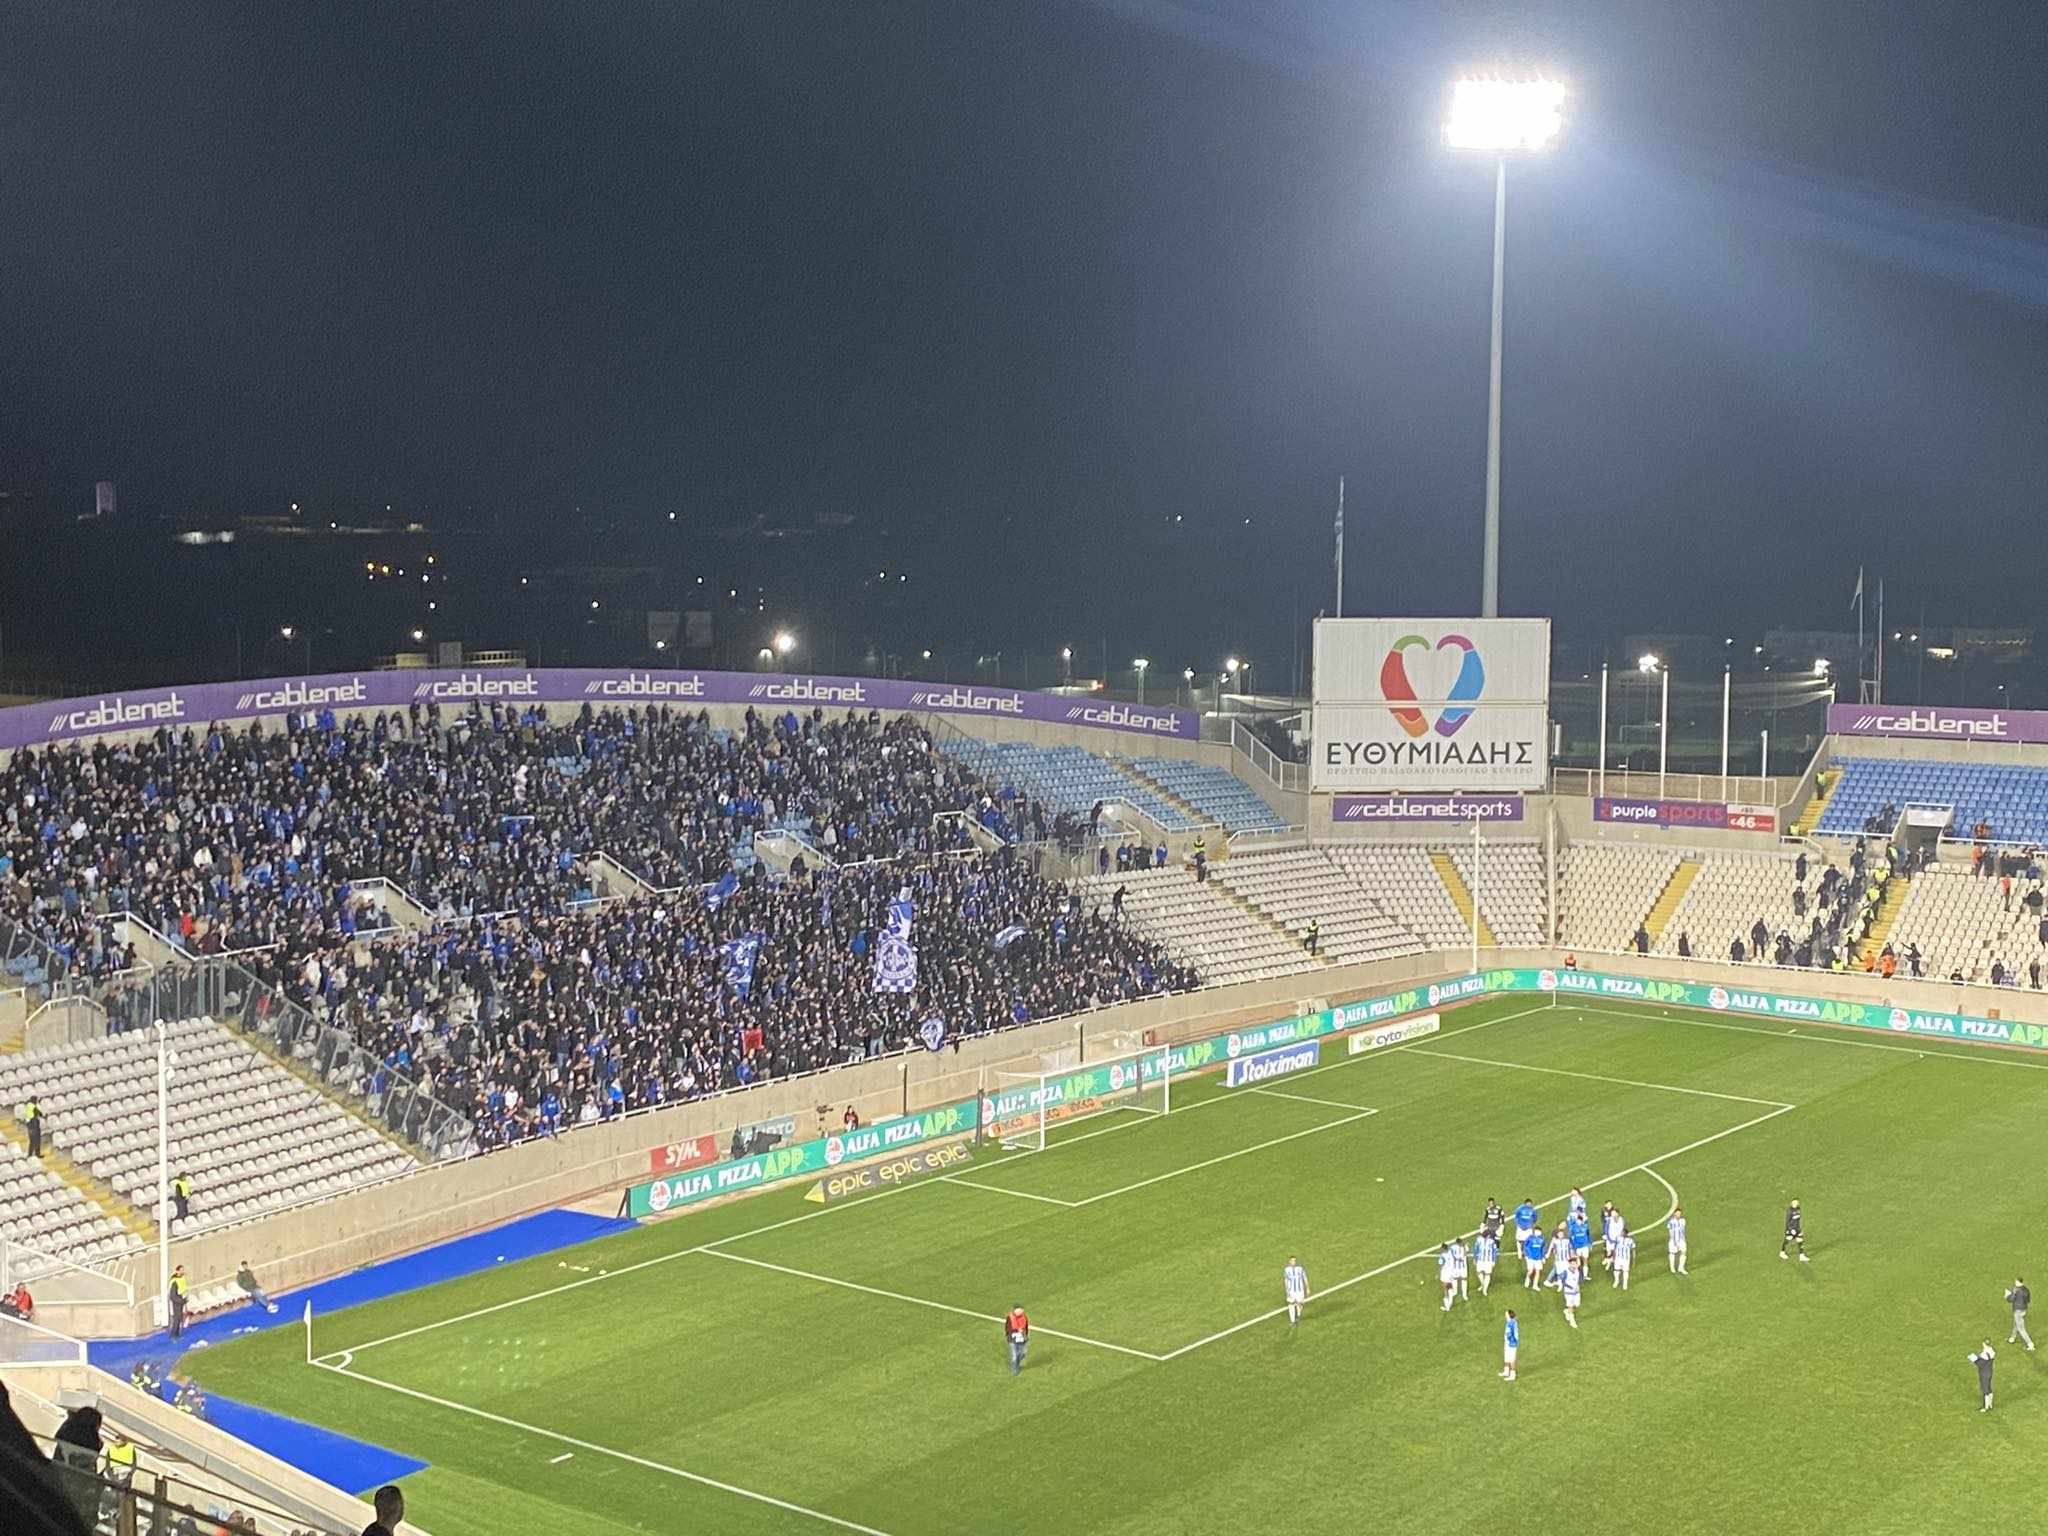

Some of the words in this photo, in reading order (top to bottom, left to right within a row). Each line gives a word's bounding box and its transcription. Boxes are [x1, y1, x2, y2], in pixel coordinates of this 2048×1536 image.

[255, 678, 366, 709] cablenet
[433, 673, 537, 697] cablenet
[603, 674, 704, 696] cablenet
[766, 678, 866, 702] cablenet
[69, 692, 185, 729] cablenet
[927, 688, 1024, 713] cablenet
[1083, 705, 1181, 733] cablenet
[1876, 710, 2008, 736] cablenet
[1327, 742, 1533, 765] ΕΥΘΥΜΙΑΔΗΣ
[1484, 970, 1514, 992] APP
[1561, 974, 1597, 990] ALFA
[1602, 979, 1643, 994] PIZZA
[1644, 981, 1685, 1001] APP
[1393, 991, 1416, 1014] APP
[1731, 994, 1769, 1010] ALFA
[1775, 999, 1820, 1015] PIZZA
[1821, 1001, 1865, 1022] APP
[1295, 1016, 1320, 1037] APP
[1913, 1016, 1955, 1032] ALFA
[1961, 1021, 2009, 1038] PIZZA
[1185, 1042, 1212, 1068] APP
[1239, 1051, 1314, 1085] Stoiximan
[1063, 1074, 1093, 1100] APP
[846, 1131, 880, 1154] ALFA
[885, 1121, 922, 1143] PIZZA
[922, 1108, 958, 1137] APP
[666, 1140, 700, 1167] SYM
[673, 1174, 712, 1199] ALFA
[718, 1161, 762, 1187] PIZZA
[762, 1147, 804, 1180] APP
[828, 1171, 871, 1195] epic
[880, 1157, 922, 1181] epic
[925, 1144, 967, 1167] epic
